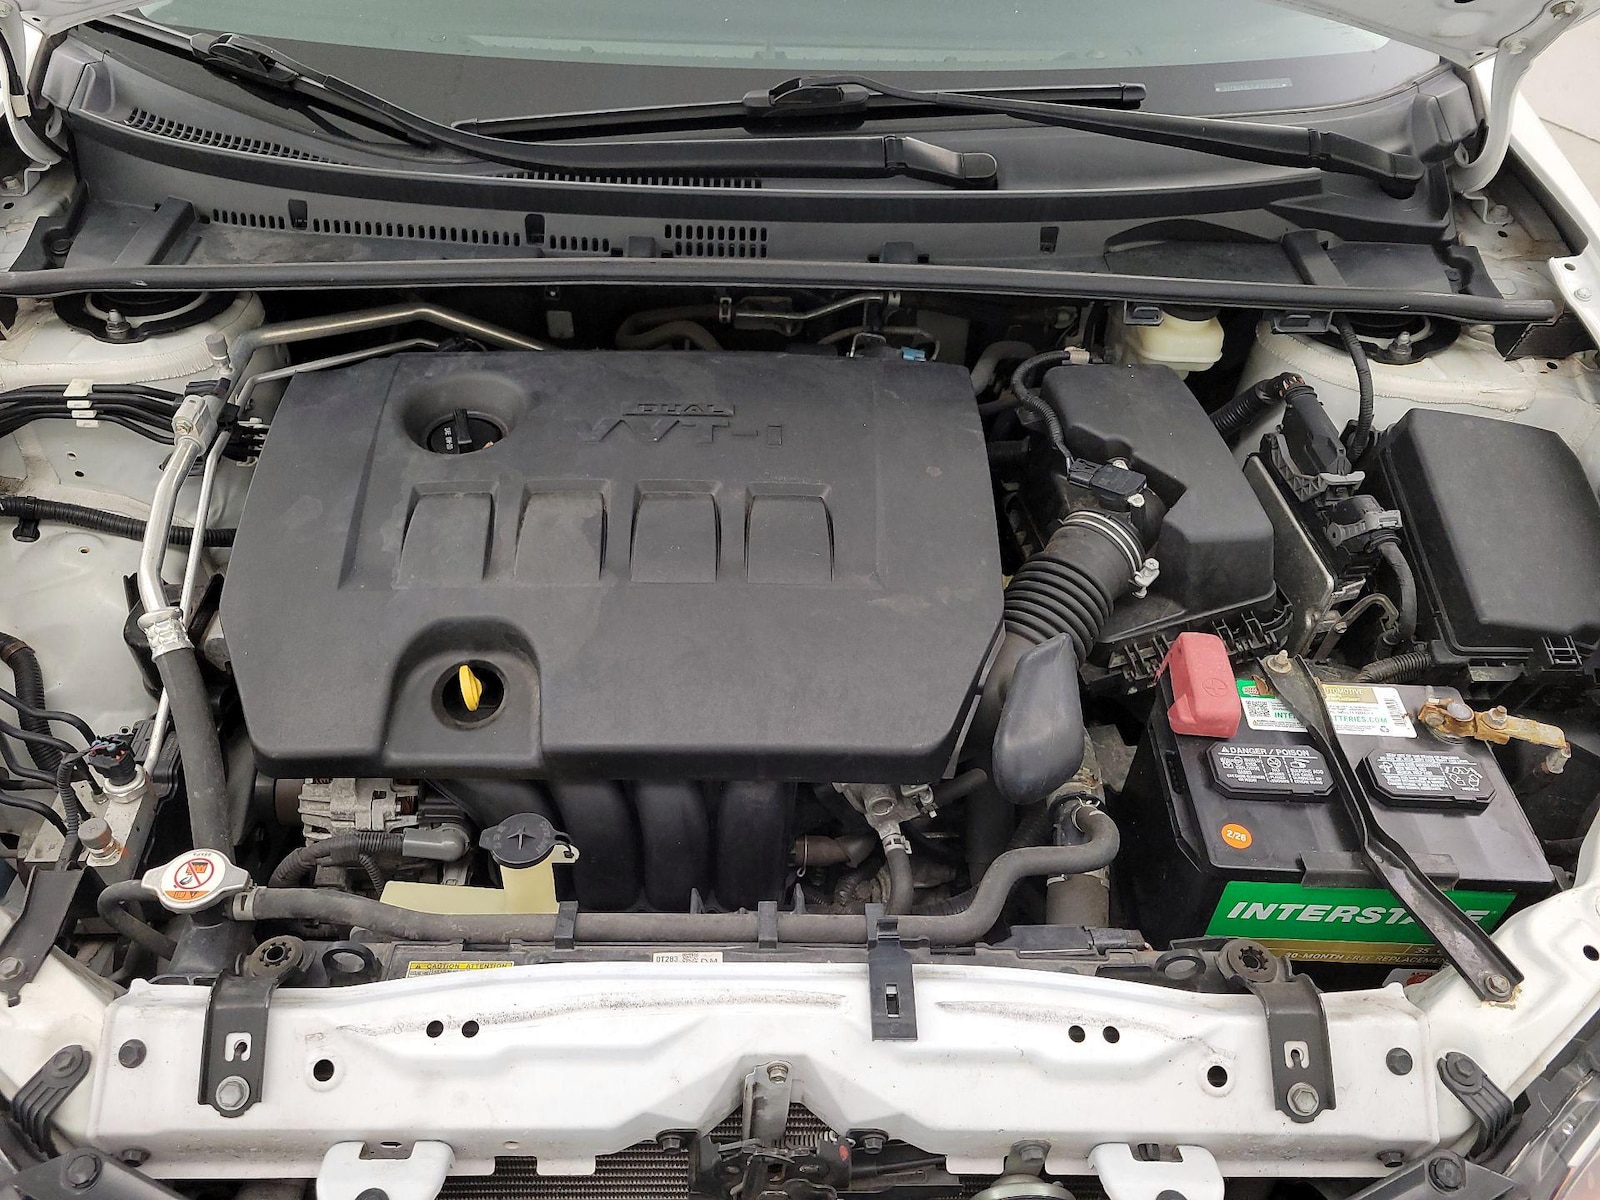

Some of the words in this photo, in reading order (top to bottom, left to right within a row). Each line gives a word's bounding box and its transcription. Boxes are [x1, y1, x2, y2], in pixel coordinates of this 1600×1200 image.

[1230, 746, 1268, 755] DANGER
[1275, 748, 1310, 757] POISON
[1226, 829, 1247, 842] 2/26
[1227, 902, 1490, 925] INTERSTE
